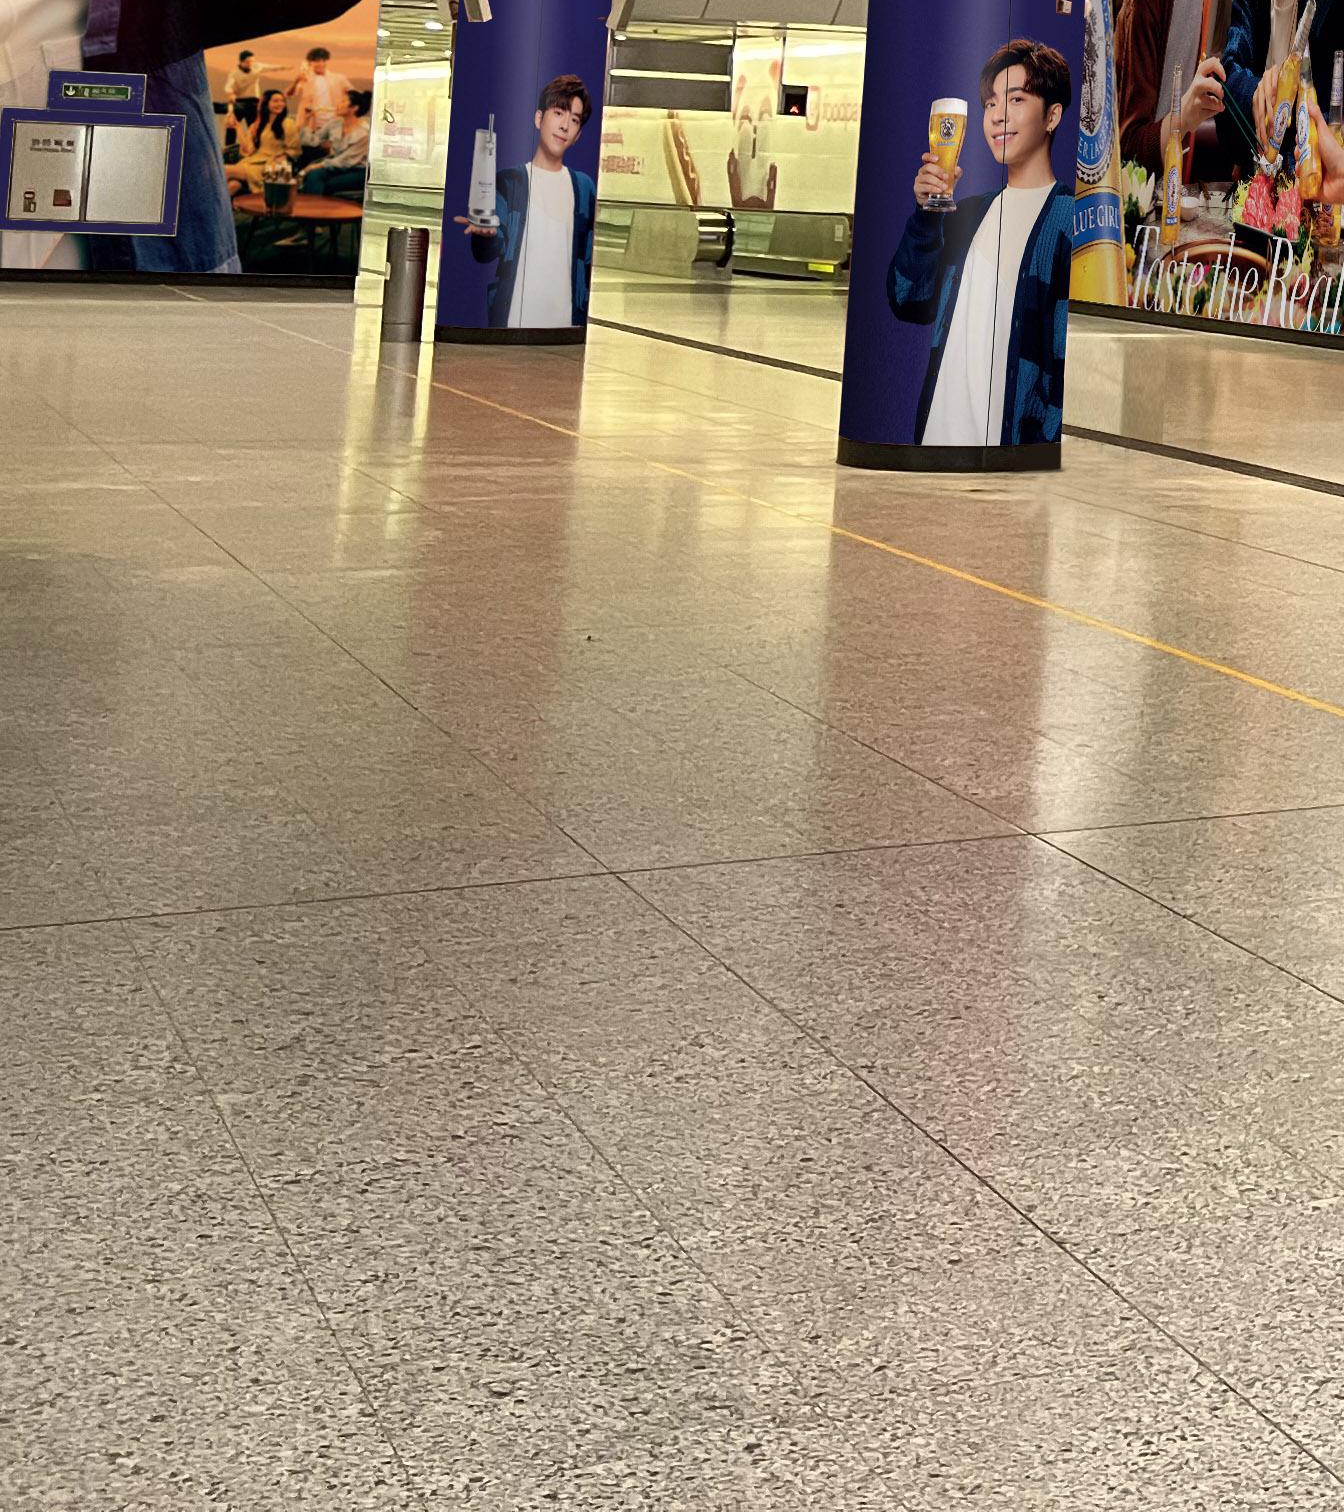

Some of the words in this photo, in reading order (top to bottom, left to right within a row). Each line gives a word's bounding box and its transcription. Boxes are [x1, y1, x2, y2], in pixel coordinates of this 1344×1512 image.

[1097, 204, 1120, 228] GIRL
[1131, 224, 1203, 314] Taste
[1208, 232, 1260, 324] the
